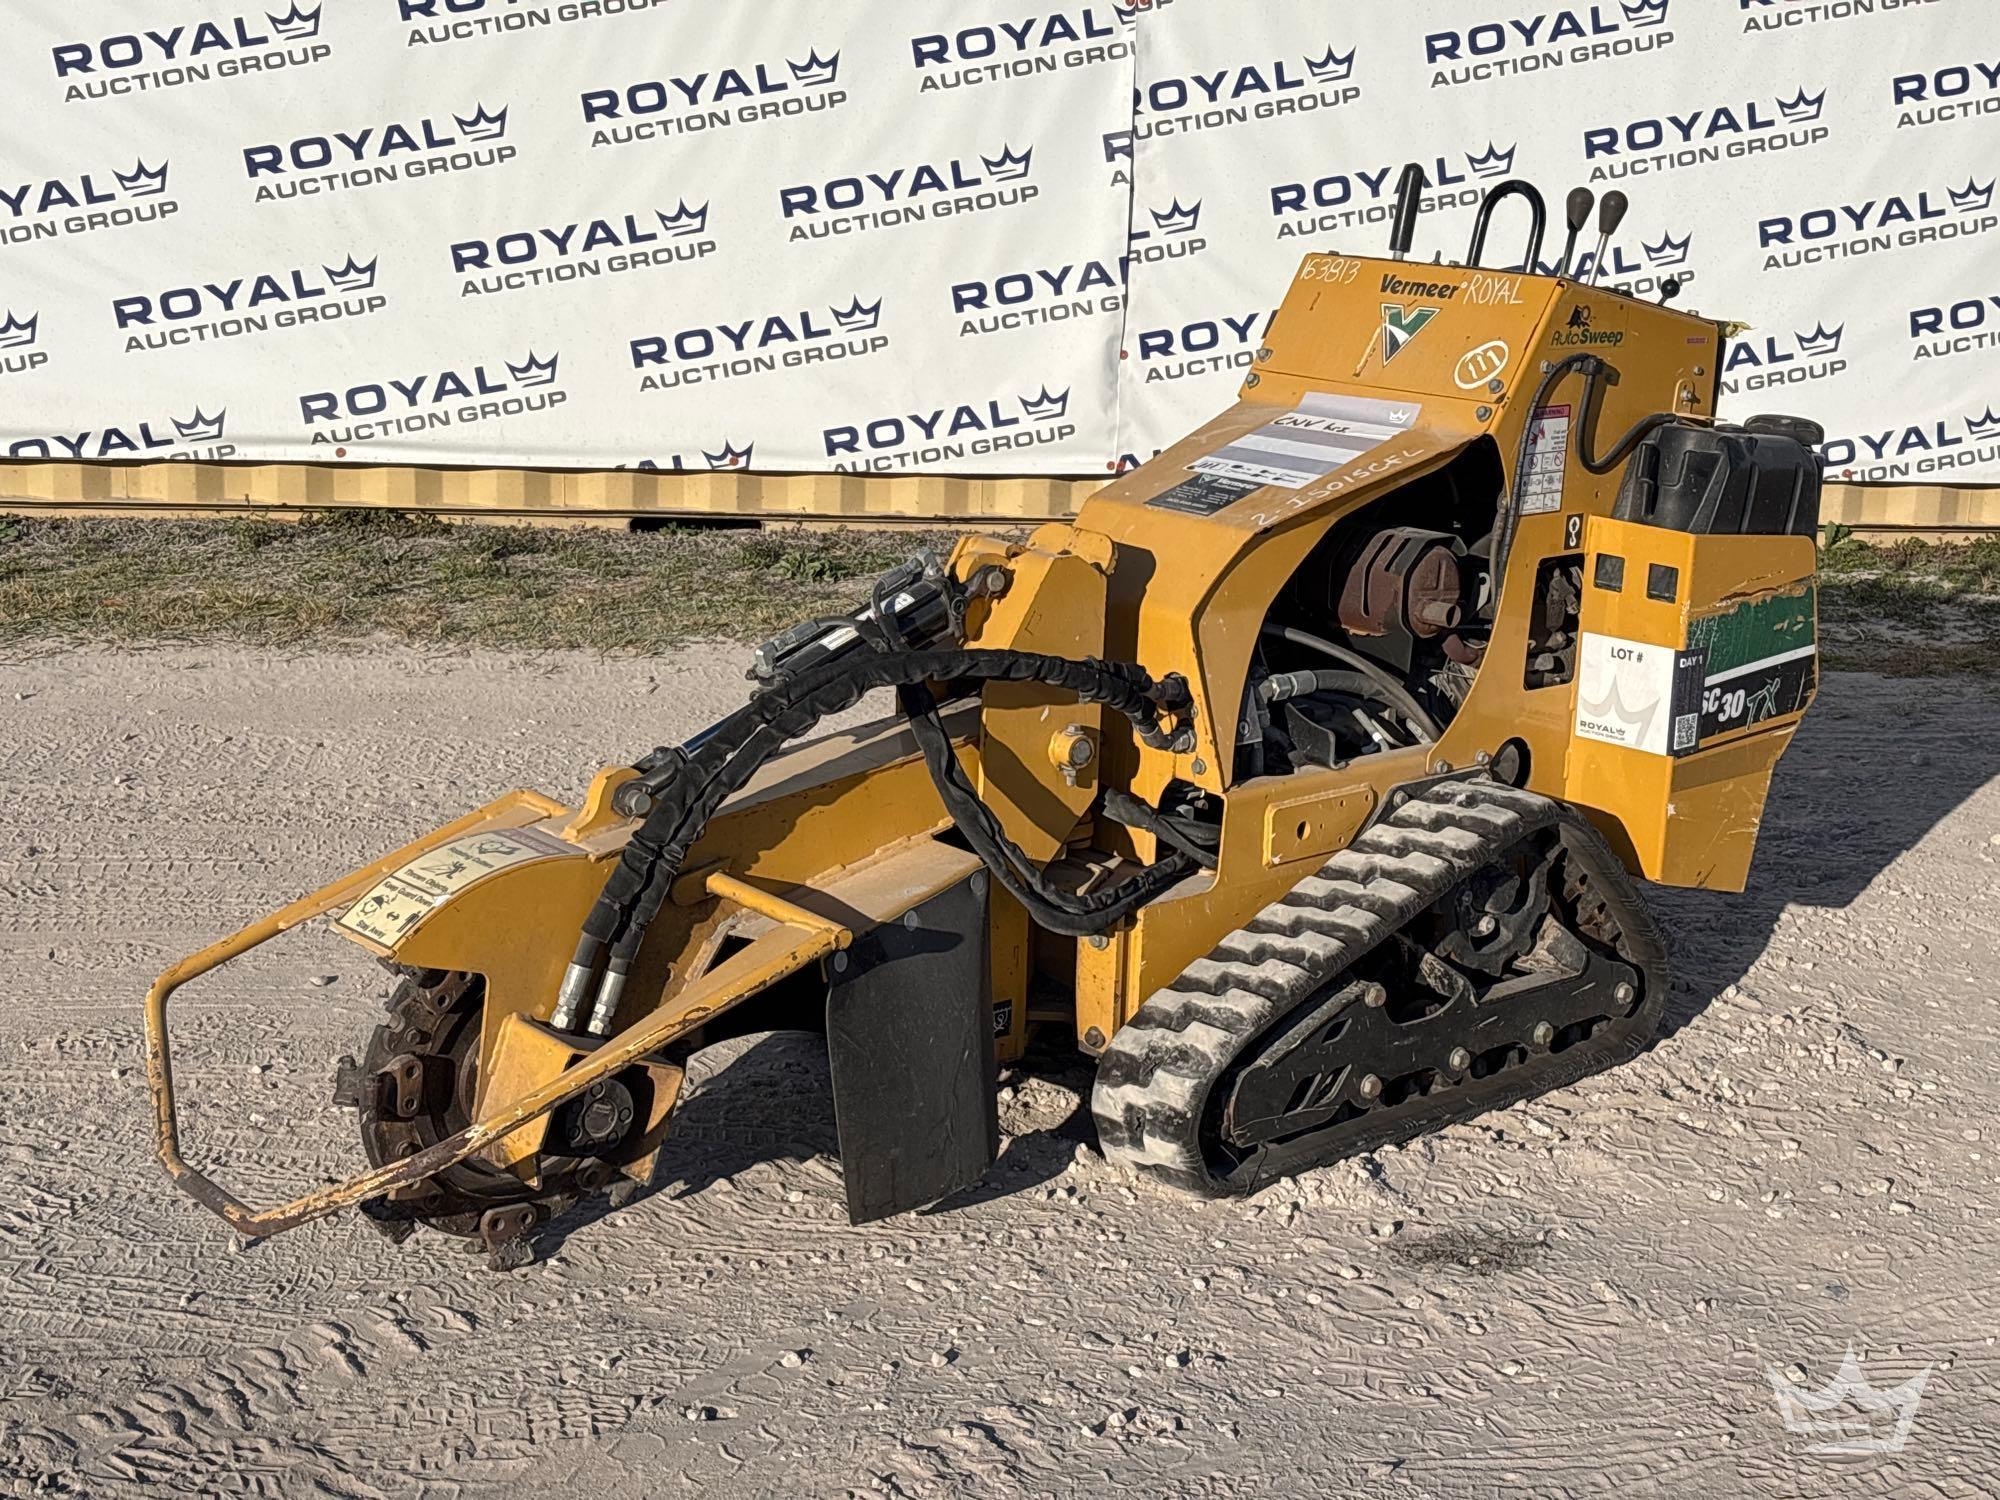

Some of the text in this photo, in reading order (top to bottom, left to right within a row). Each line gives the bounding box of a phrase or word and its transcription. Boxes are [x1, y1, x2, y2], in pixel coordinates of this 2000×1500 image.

[408, 9, 550, 46] AUCTION
[912, 9, 1113, 68] ROYAL
[1425, 6, 1619, 64] ROYAL
[1744, 0, 1873, 33] AUCTION
[52, 17, 268, 77] ROYAL
[65, 45, 330, 102] AUCTION GROUP
[920, 42, 1135, 92] AUCTION GRO
[1431, 32, 1673, 88] AUCTION GROUP
[581, 64, 788, 122] ROYAL
[1893, 61, 2000, 105] ROY
[592, 91, 846, 147] AUCTION GROUP
[1134, 87, 1360, 141] UCTION GROUP
[1584, 102, 1775, 159] ROYAL
[1897, 97, 2000, 129] AUCTIO
[243, 119, 455, 178] ROYAL
[256, 146, 516, 202] AUCTION GROUP
[1590, 127, 1828, 182] AUCTION GROUP
[0, 175, 116, 217] YAL
[780, 160, 981, 218] ROYAL
[790, 186, 1038, 242] AUCTION GROUP
[65, 201, 178, 233] GROUP
[451, 215, 657, 272] ROYAL
[1759, 192, 1945, 248] ROYAL
[1764, 216, 1997, 270] AUCTION GROUP
[462, 241, 716, 296] AUCTION GROUP
[1128, 239, 1206, 264] ROUP
[113, 270, 325, 328] ROYAL
[951, 256, 1128, 314] ROYA
[1380, 273, 1459, 300] Vermeer
[1463, 274, 1524, 306] ROYAL
[126, 296, 386, 352] AUCTION GROUP
[630, 311, 831, 368] ROYAL
[960, 301, 1092, 336] AUCTION
[1139, 309, 1279, 361] ROY
[1551, 327, 1624, 347] AutoSweep
[641, 336, 888, 391] AUCTION GROUP
[1145, 350, 1255, 384] AUCTIO
[1913, 331, 2000, 361] AUCTI
[300, 366, 508, 424] ROYAL
[1747, 360, 1846, 390] GROUP
[9, 422, 174, 457] OYAL
[311, 391, 566, 445] AUCTION GROUP
[824, 401, 1019, 456] ROYAL
[972, 425, 1075, 454] GROUP
[1821, 421, 1963, 467] OYAL
[1917, 446, 2000, 473] GROU
[1611, 646, 1643, 663] LOT #
[1679, 655, 1703, 668] DAY 1
[1580, 720, 1615, 734] ROYAL
[382, 880, 398, 892] Keep
[355, 919, 387, 939] Stay Away
